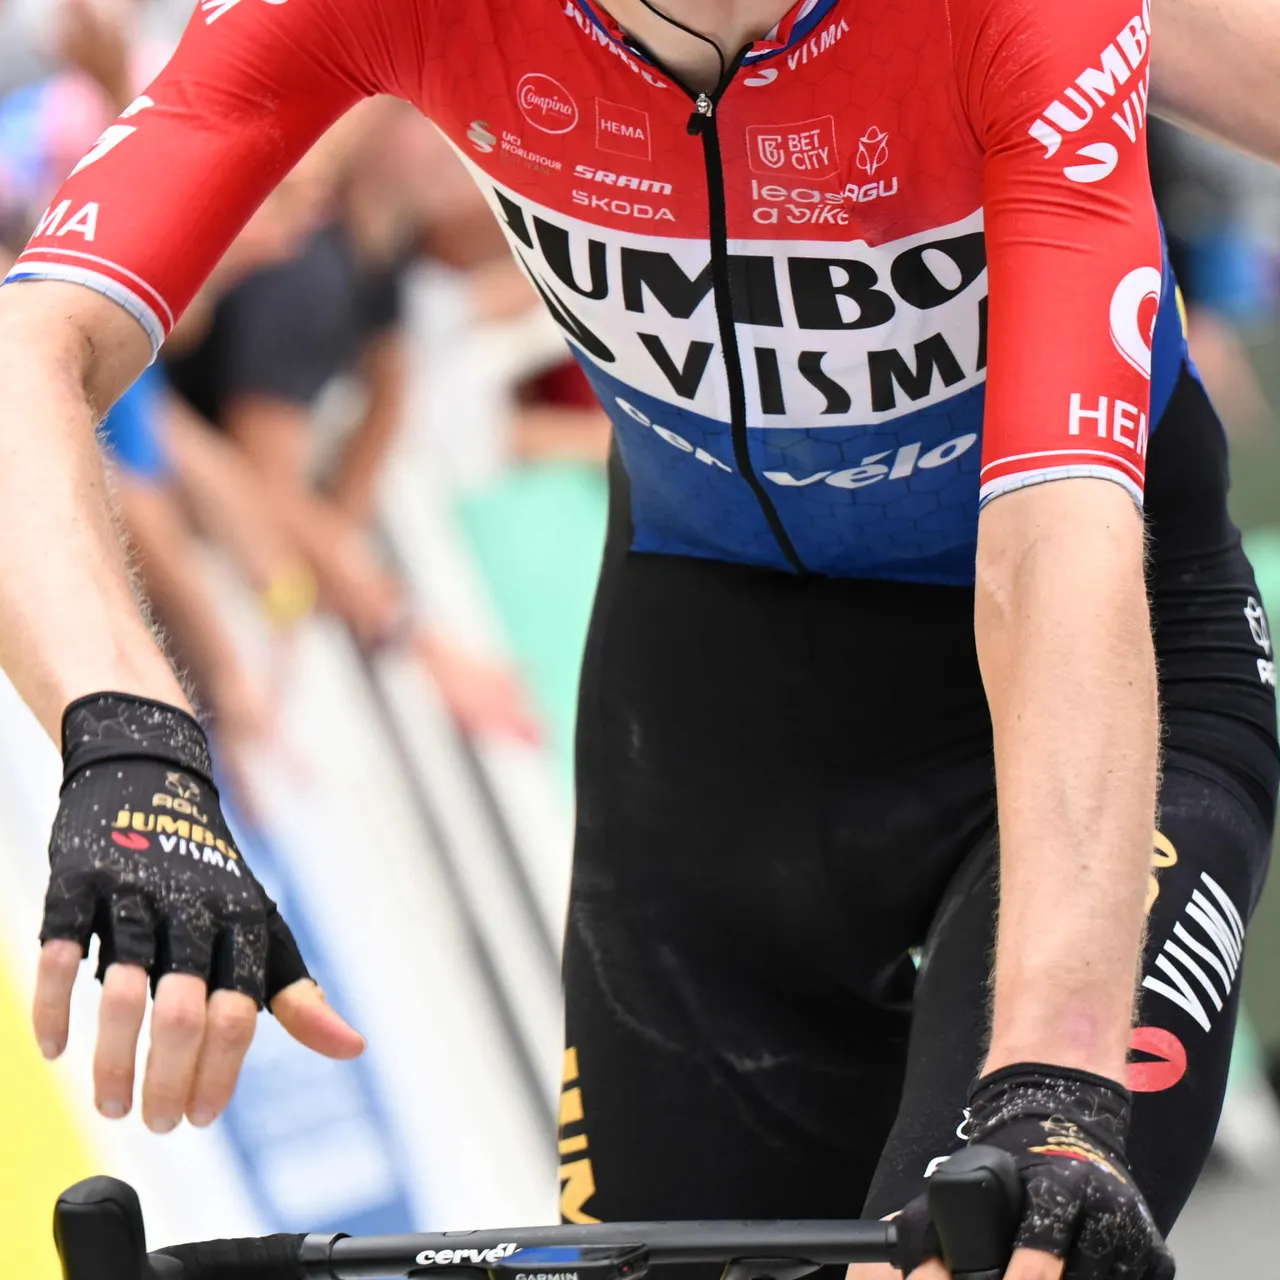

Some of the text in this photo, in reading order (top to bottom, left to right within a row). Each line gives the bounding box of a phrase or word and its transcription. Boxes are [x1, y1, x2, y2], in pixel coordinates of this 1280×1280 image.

[787, 16, 850, 71] VISMA
[520, 85, 572, 115] Campina
[502, 131, 521, 146] UCI
[600, 119, 645, 140] HEMA
[788, 129, 820, 152] BET
[501, 141, 563, 171] WORLDTOUR
[791, 147, 829, 171] CITY
[573, 164, 673, 195] SRAM
[751, 179, 847, 204] leas
[842, 176, 899, 203] AGU
[752, 207, 778, 224] a
[111, 810, 240, 861] JUMBO
[158, 834, 242, 877] VISMA
[1142, 871, 1245, 1033] VISMA
[415, 1242, 523, 1265] cervél
